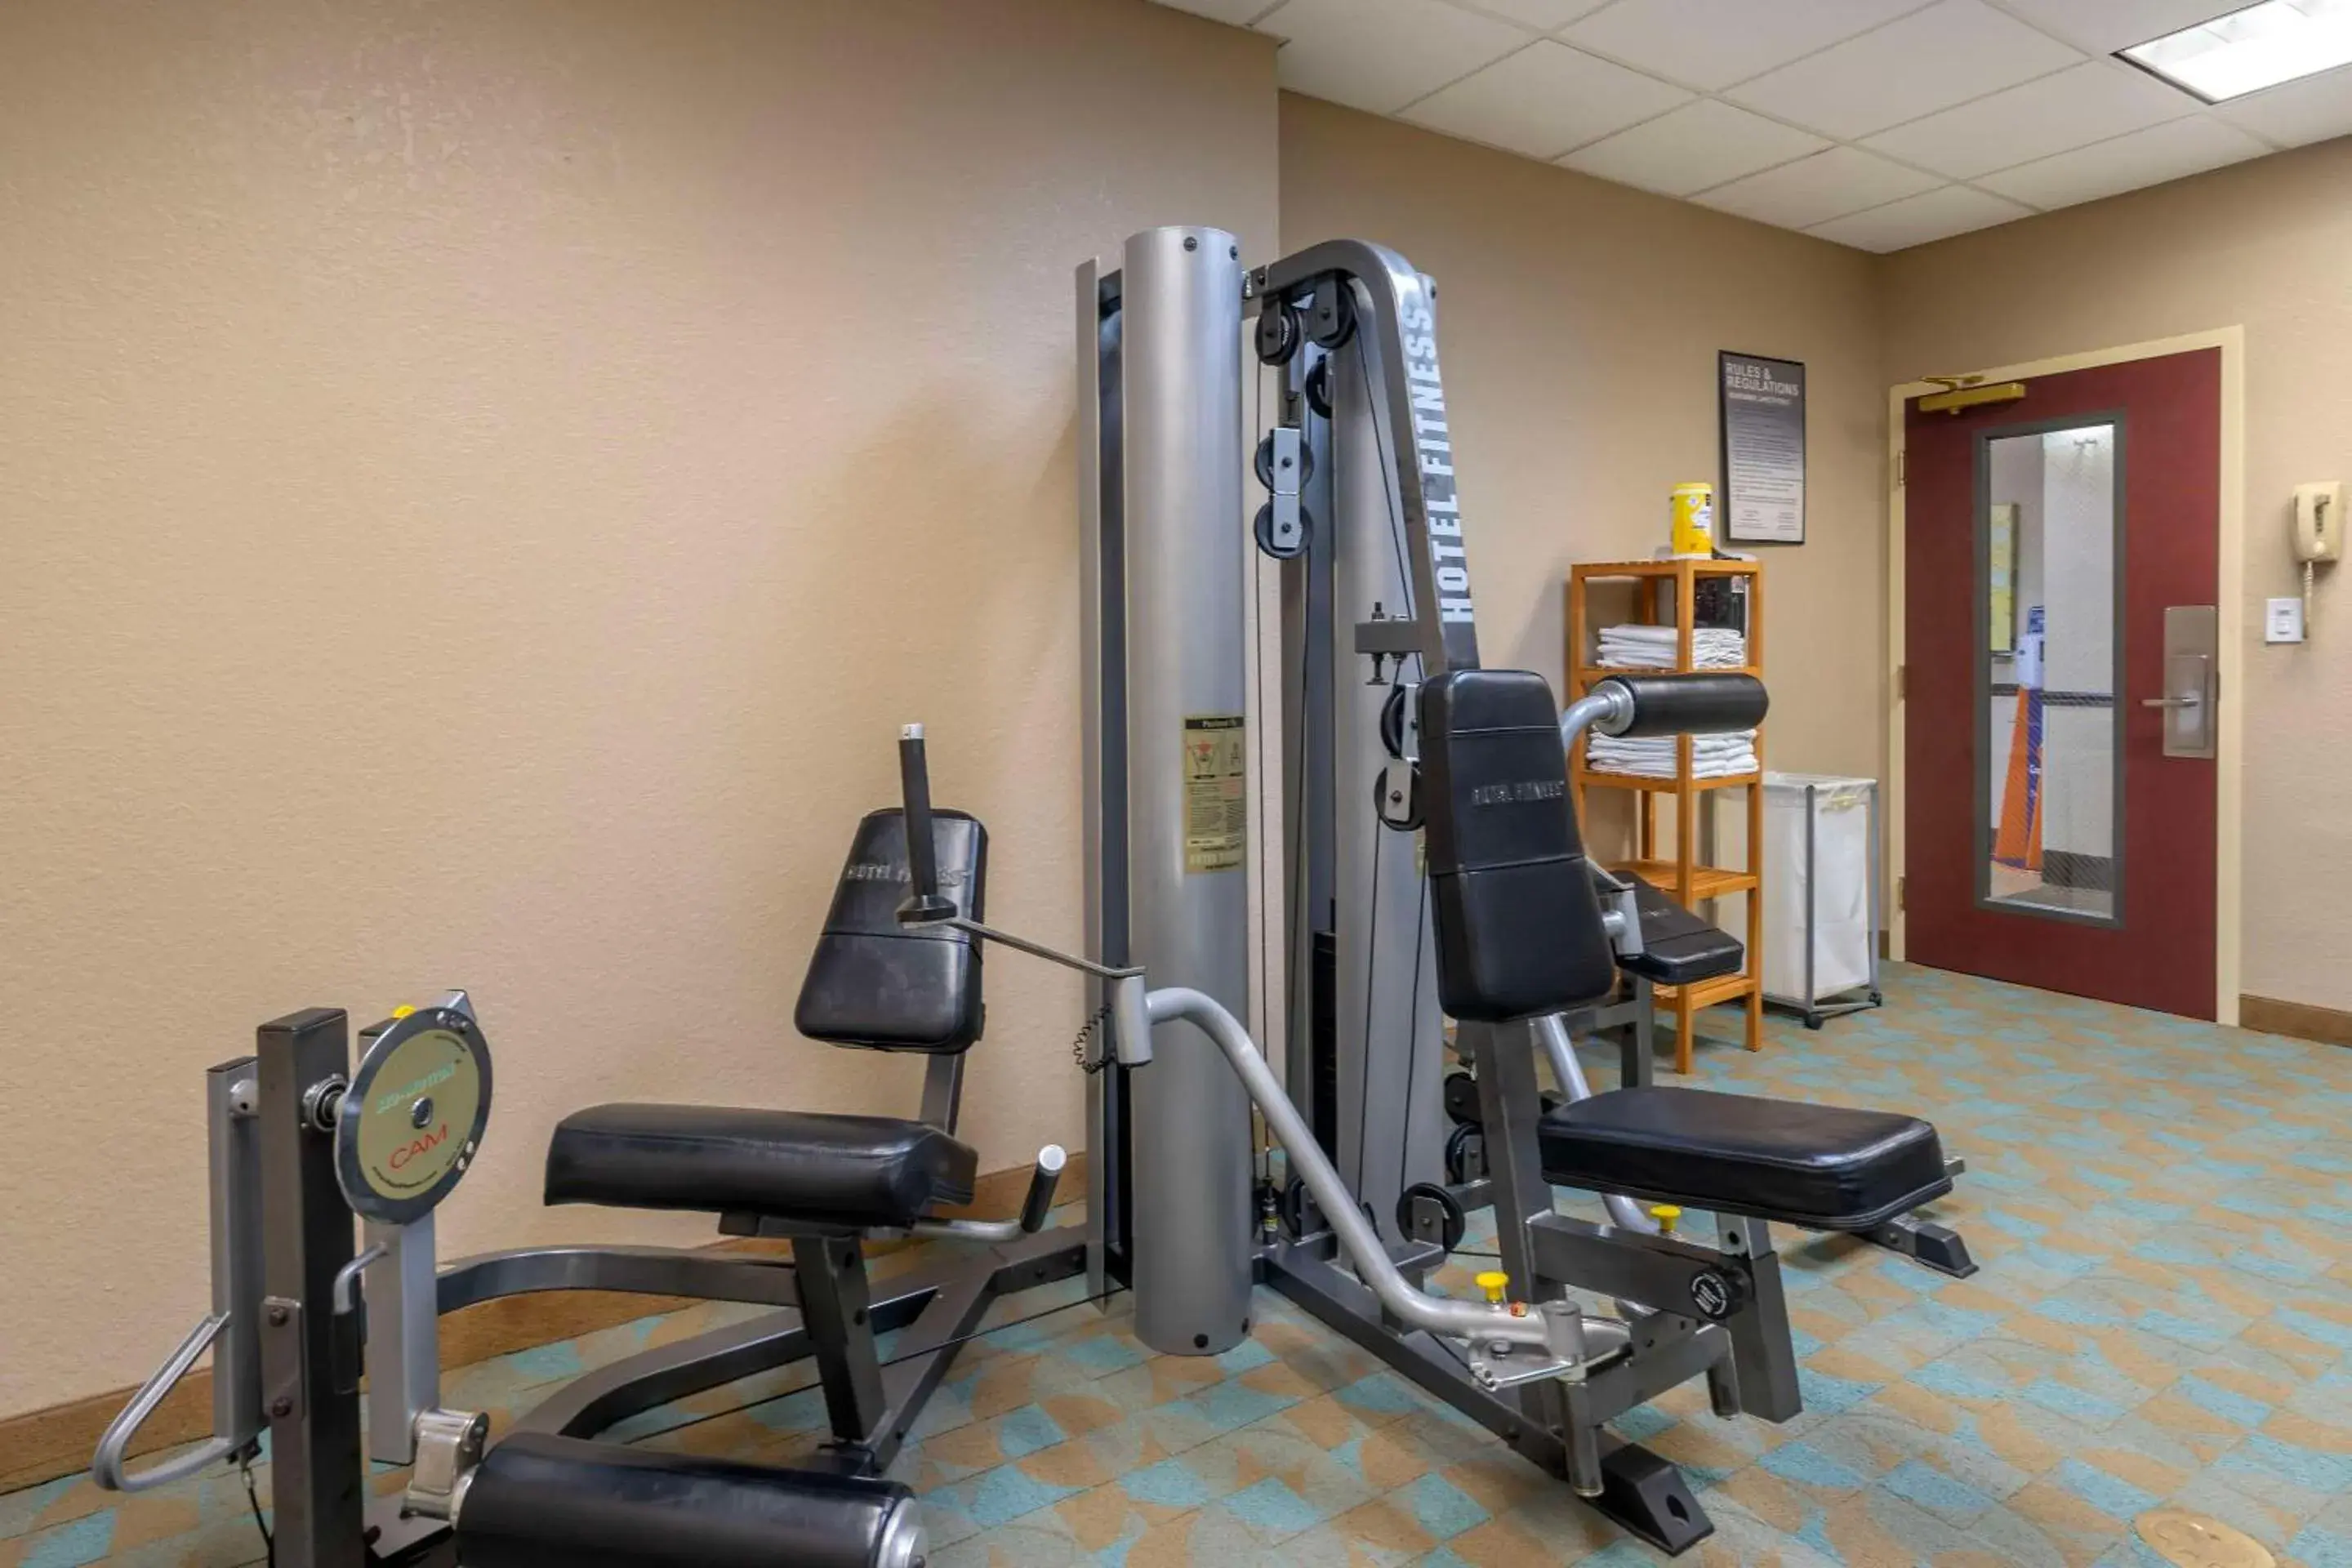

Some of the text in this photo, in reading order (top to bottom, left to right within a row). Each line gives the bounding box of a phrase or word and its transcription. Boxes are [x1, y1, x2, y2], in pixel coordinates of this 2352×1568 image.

[1725, 362, 1772, 381] RULES &
[1725, 376, 1800, 397] REGULATIONS
[1402, 305, 1473, 623] HOTEL FITNESS
[390, 1122, 448, 1169] CAM
